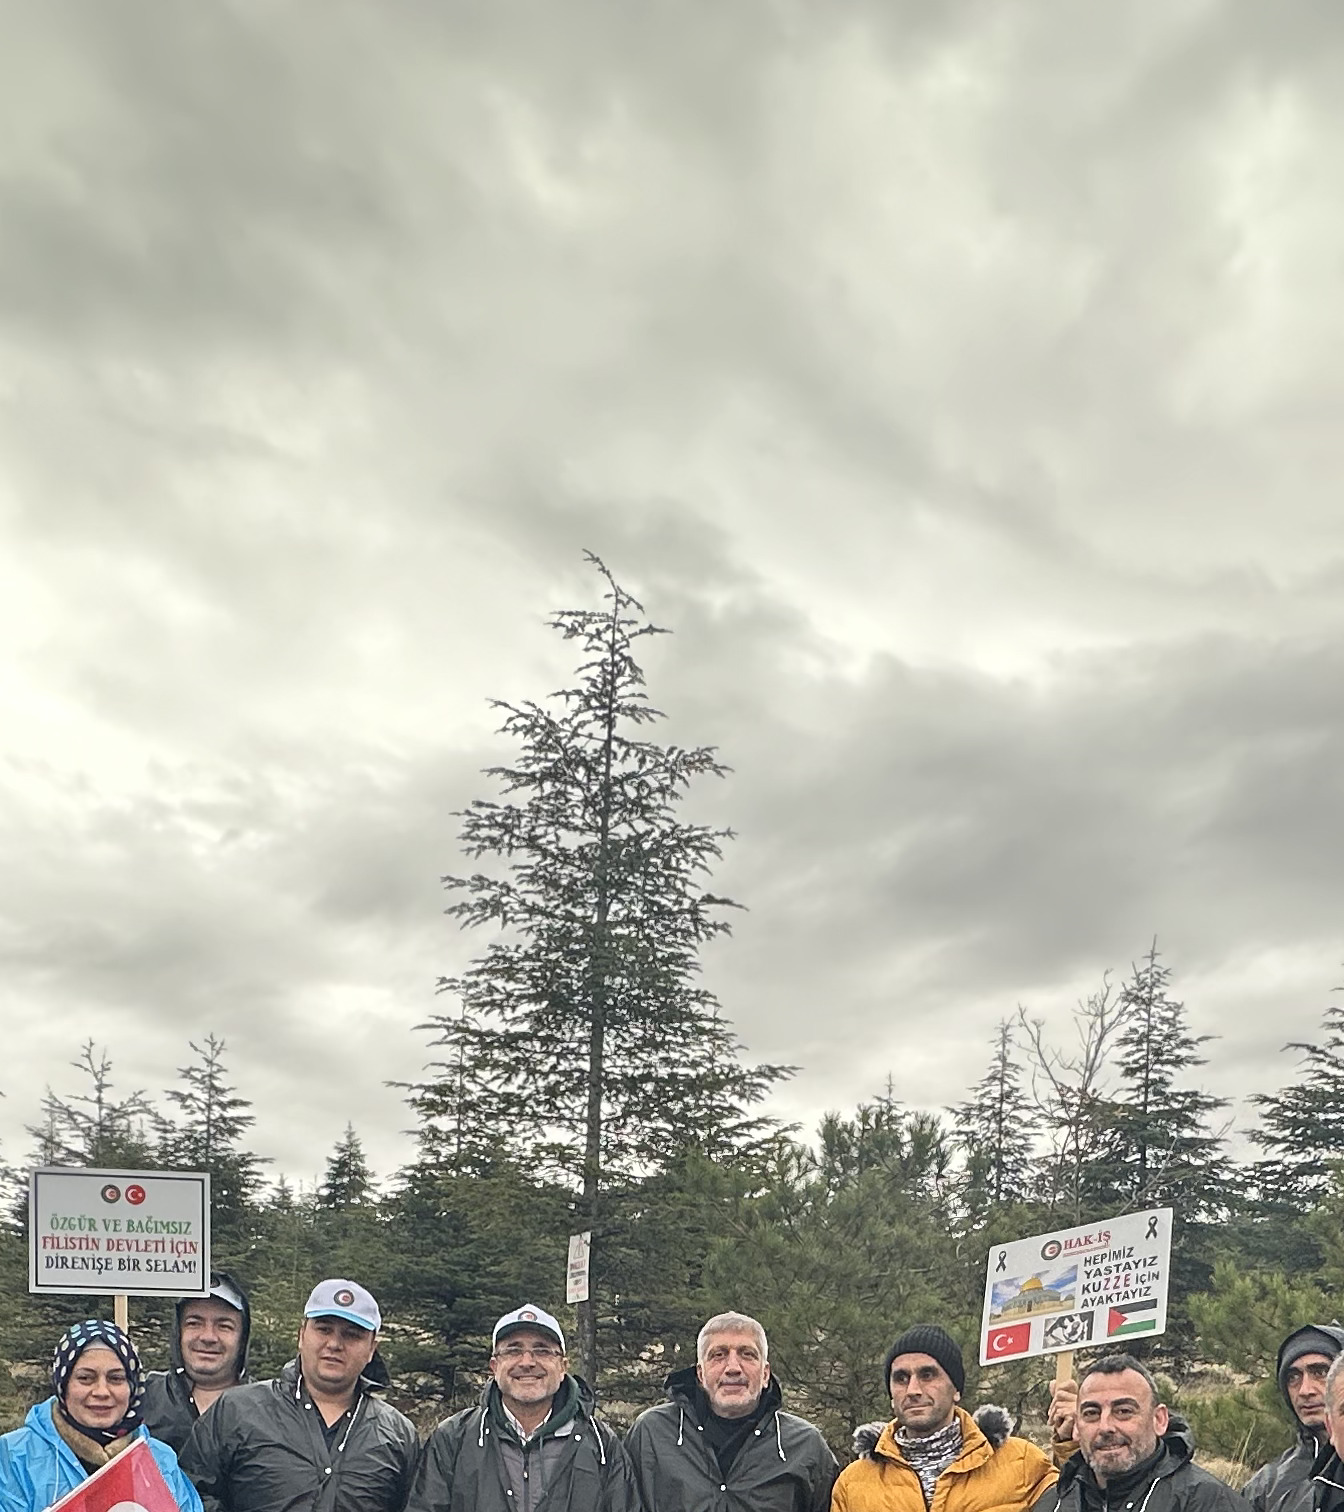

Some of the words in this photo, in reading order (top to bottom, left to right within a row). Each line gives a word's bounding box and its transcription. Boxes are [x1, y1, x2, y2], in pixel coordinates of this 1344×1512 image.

[50, 1213, 98, 1232] ÖZGÜR
[102, 1218, 122, 1232] VE
[126, 1215, 192, 1235] BAĞIMSIZ
[41, 1233, 101, 1251] FİLİSTİN
[106, 1237, 166, 1254] DEVLETİ
[170, 1238, 199, 1258] İÇİN
[1063, 1229, 1112, 1249] HAK-İŞ
[45, 1253, 114, 1275] DİRENİŞE
[117, 1256, 142, 1272] BİR
[145, 1259, 197, 1274] SELAM!
[1083, 1255, 1159, 1280] YASTAYIZ
[1084, 1246, 1135, 1267] HEPİMİZ
[1081, 1273, 1131, 1295] KUZZE
[1135, 1270, 1160, 1286] İÇİN
[1080, 1286, 1153, 1309] AYAKTAYIZ
